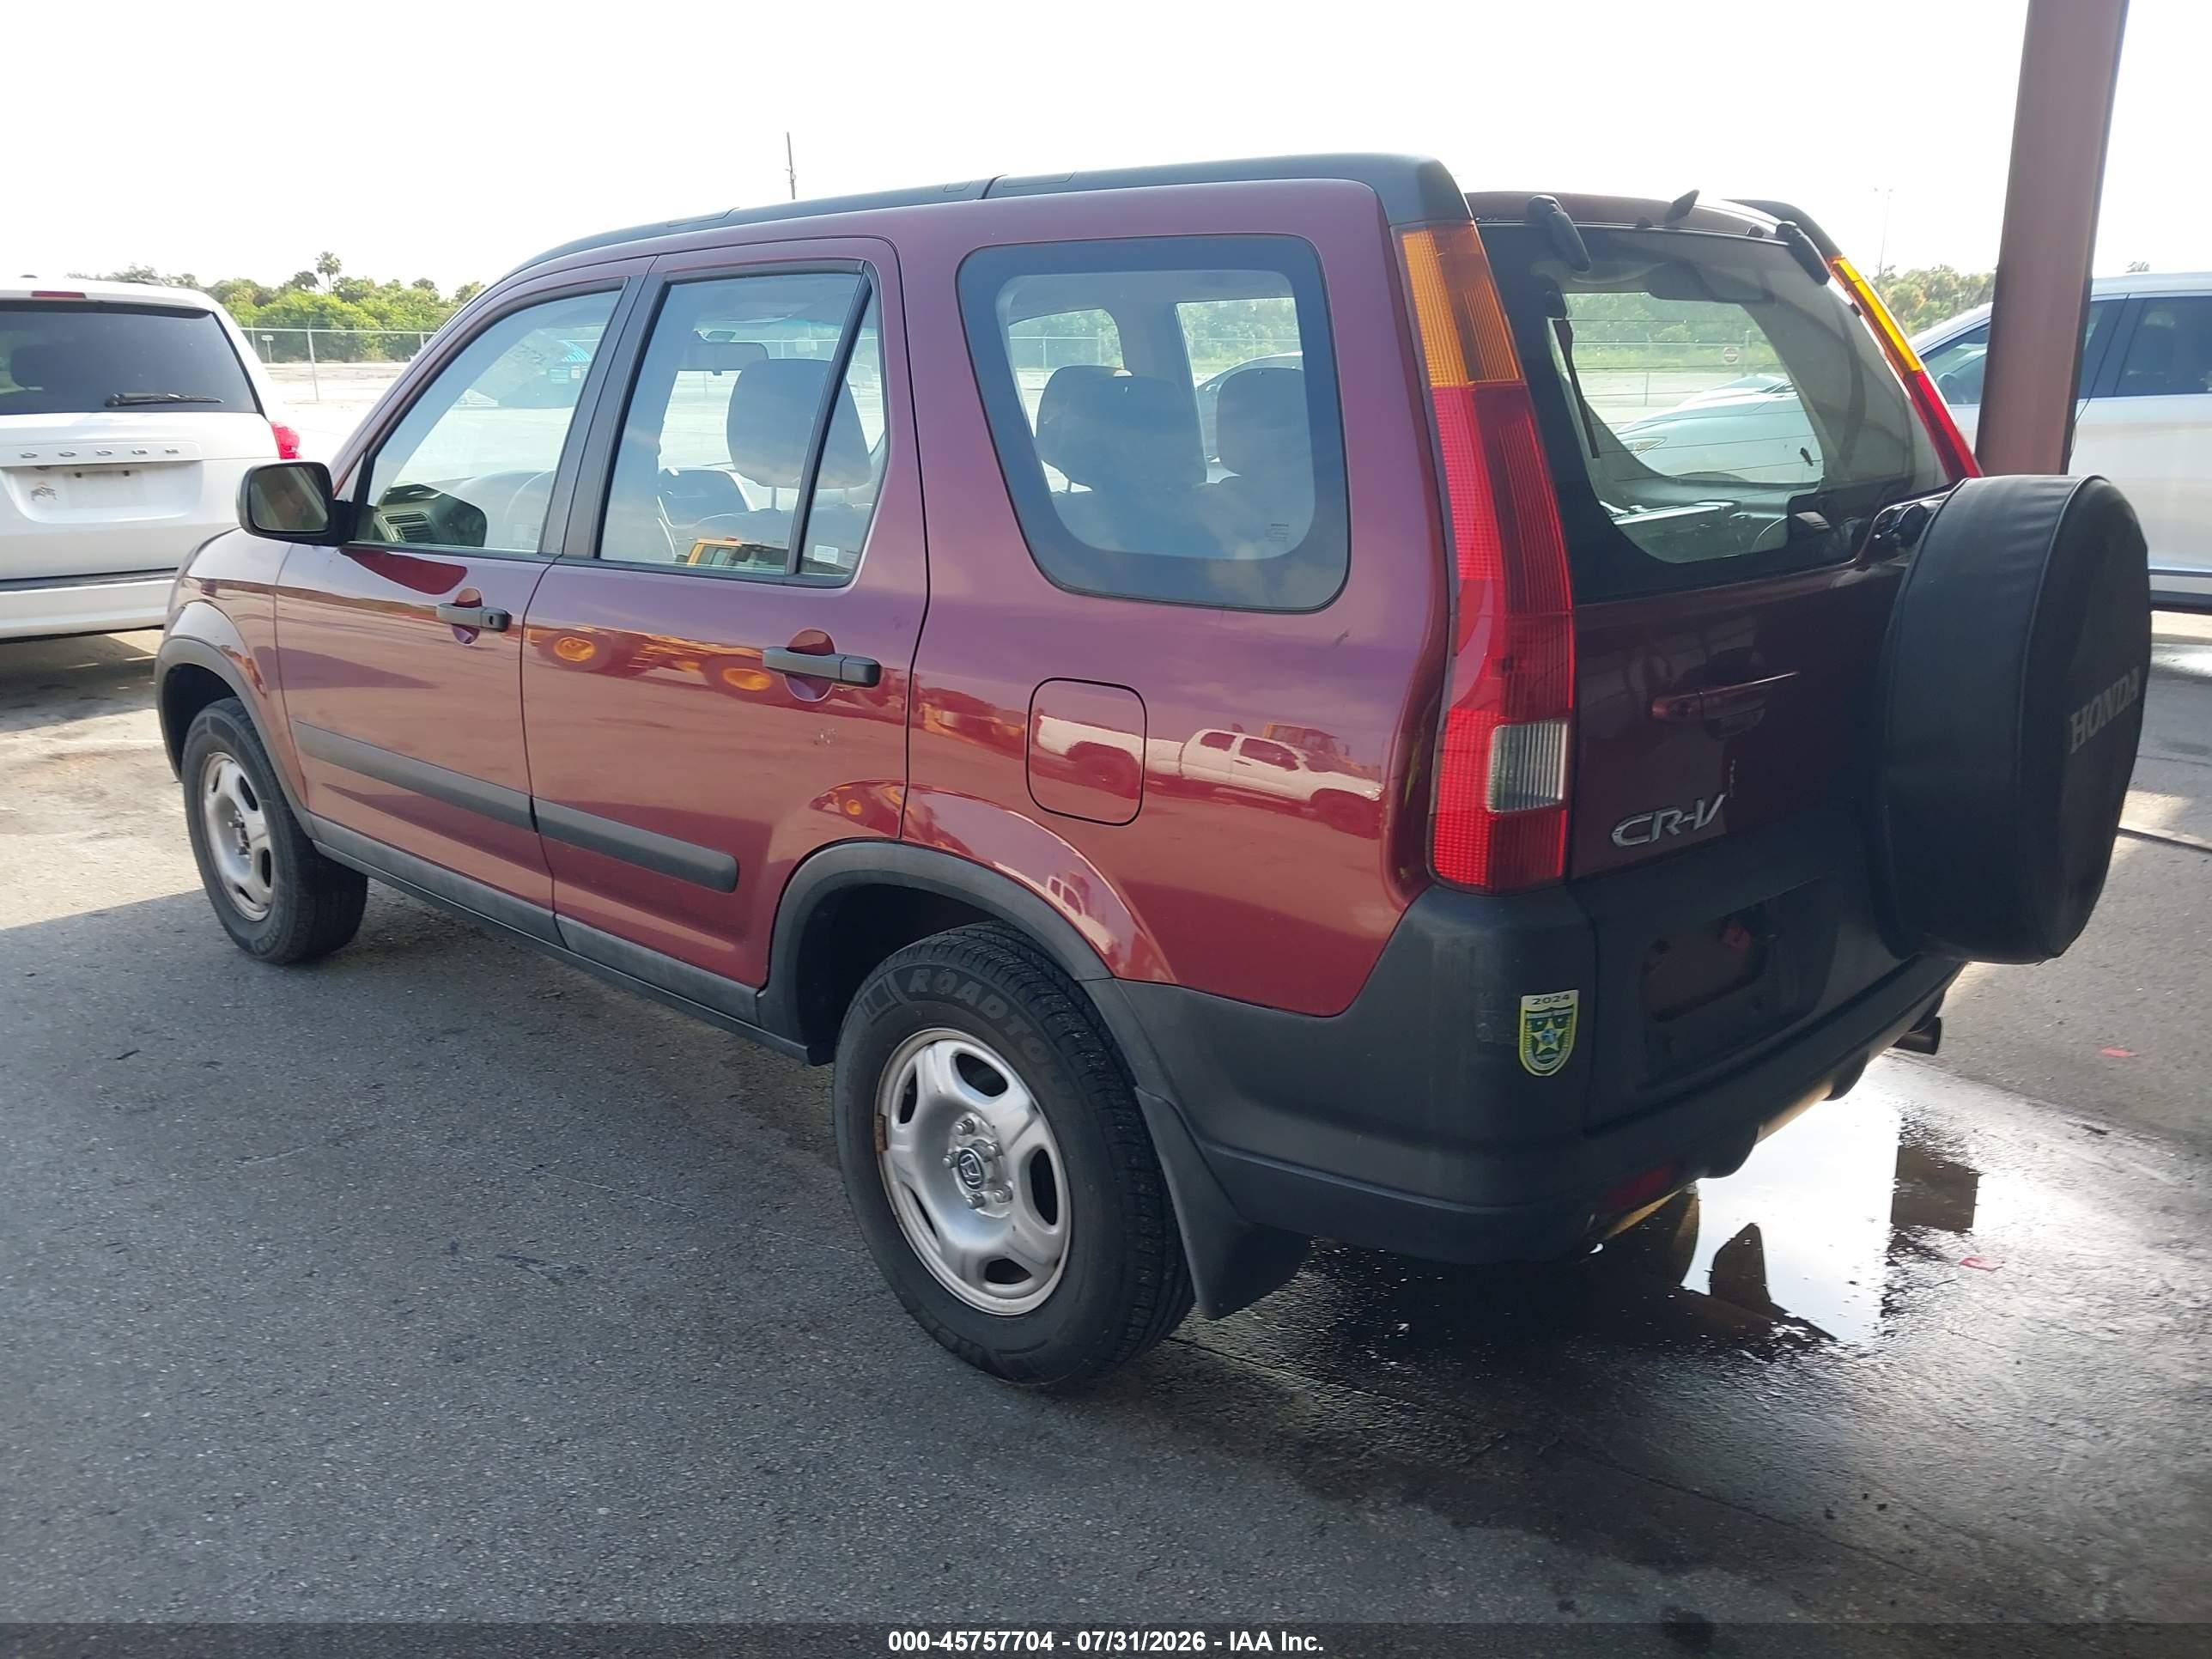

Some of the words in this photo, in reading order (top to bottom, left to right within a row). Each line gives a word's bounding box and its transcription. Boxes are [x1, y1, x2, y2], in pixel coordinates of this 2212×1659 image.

[20, 446, 180, 459] DODGE
[2069, 665, 2141, 755] HONDA
[1611, 793, 1727, 847] CR-V
[1531, 994, 1571, 1006] 2024
